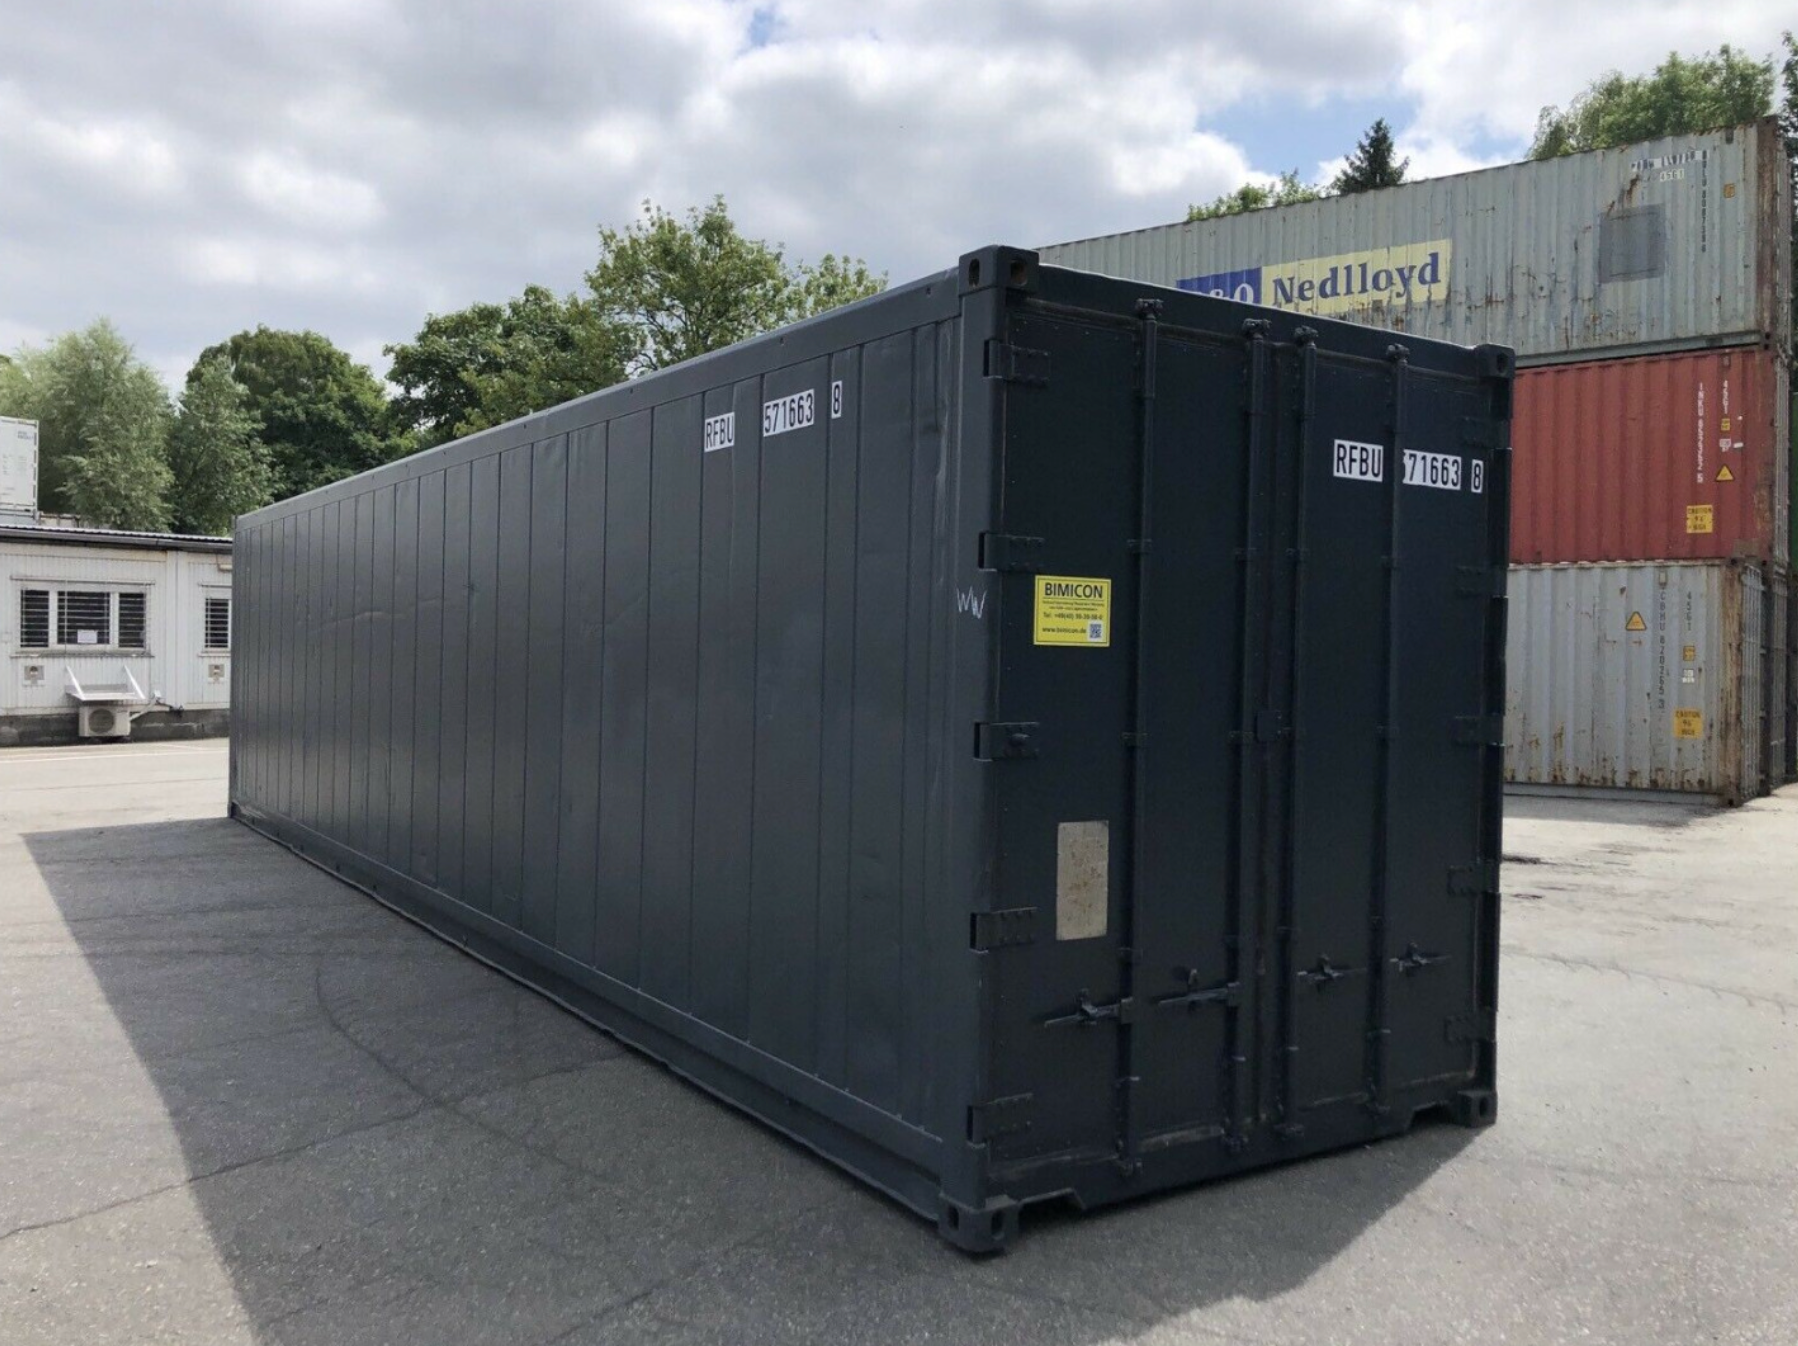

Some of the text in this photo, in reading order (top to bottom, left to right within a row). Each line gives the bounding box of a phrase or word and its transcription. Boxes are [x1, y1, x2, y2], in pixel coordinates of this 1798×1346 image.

[1273, 252, 1440, 305] Nedlloyd
[706, 382, 842, 450] RFBU 571663 8
[1335, 442, 1483, 491] RFBU 71663 8
[1044, 582, 1103, 599] BIMICON
